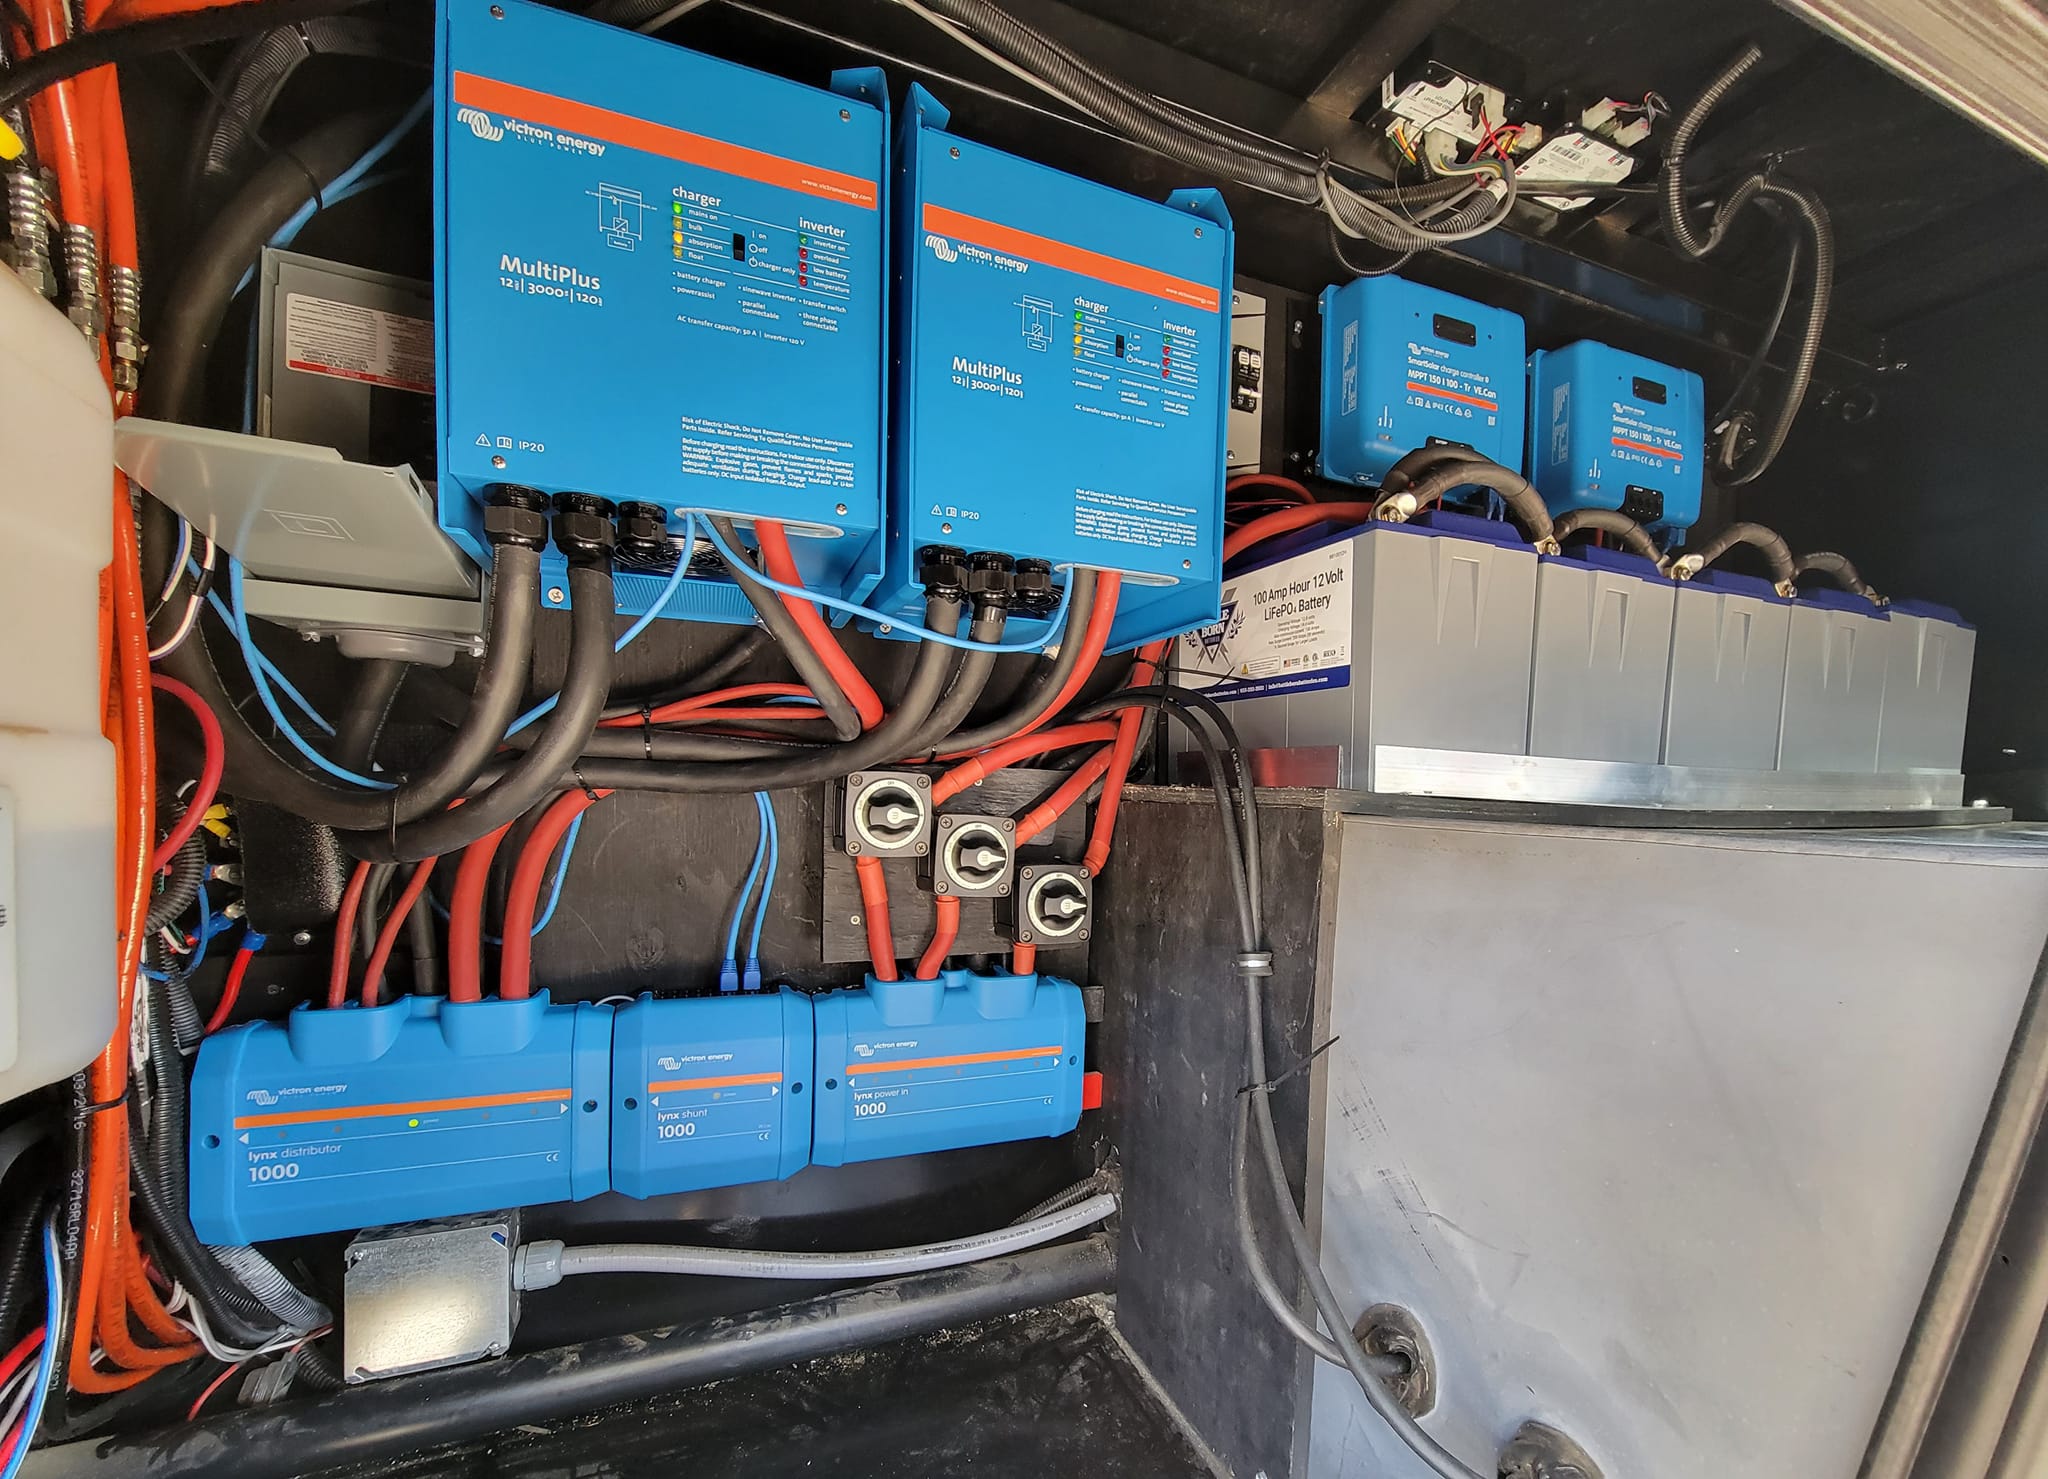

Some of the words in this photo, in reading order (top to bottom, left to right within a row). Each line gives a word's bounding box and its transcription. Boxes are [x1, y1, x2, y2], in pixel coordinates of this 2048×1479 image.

[503, 119, 553, 141] victron
[556, 134, 606, 157] energy
[672, 186, 721, 206] charger
[800, 216, 846, 238] inverter
[688, 238, 723, 251] absorption
[813, 253, 840, 264] overload
[958, 244, 992, 261] victron
[994, 255, 1028, 274] energy
[500, 254, 600, 290] MultiPlus
[758, 261, 782, 271] charger
[782, 265, 795, 276] only
[825, 269, 846, 280] battery
[677, 272, 700, 282] battery
[702, 276, 726, 288] charger
[813, 280, 850, 294] temperature
[528, 282, 564, 298] 3000
[676, 286, 715, 299] powerassist
[742, 286, 771, 298] sinewave
[803, 299, 826, 309] transfer
[1074, 296, 1108, 313] charger
[742, 307, 779, 320] connectable
[688, 316, 713, 328] transfer
[803, 320, 838, 332] connectable
[952, 356, 1022, 385] MultiPlus
[1408, 356, 1440, 371] SmartSolar
[1440, 365, 1459, 377] charge
[1460, 370, 1484, 382] controller
[1408, 369, 1427, 381] MPPT
[1429, 374, 1440, 385] 150
[1446, 378, 1458, 388] 100
[1463, 382, 1471, 392] Tr
[1473, 385, 1496, 399] VE.Can
[1613, 426, 1628, 436] MPPT
[519, 440, 545, 452] IP20
[960, 510, 980, 520] IP20
[1253, 591, 1267, 606] 100
[1268, 587, 1287, 602] Amp
[1289, 580, 1310, 596] Hour
[1313, 574, 1324, 588] 12
[1325, 568, 1343, 584] Volt
[1299, 594, 1331, 612] Battery
[1201, 622, 1225, 637] BORN
[681, 1055, 706, 1063] victron
[708, 1053, 734, 1061] energy
[278, 1087, 311, 1096] victron
[314, 1084, 348, 1092] energy
[854, 1092, 872, 1102] lynx
[874, 1089, 899, 1099] power
[658, 1112, 679, 1122] lynx
[681, 1109, 708, 1118] shunt
[854, 1102, 886, 1117] 1000
[658, 1122, 695, 1139] 1000
[248, 1151, 278, 1163] lynx
[281, 1144, 342, 1159] distributor
[248, 1163, 299, 1182] 1000
